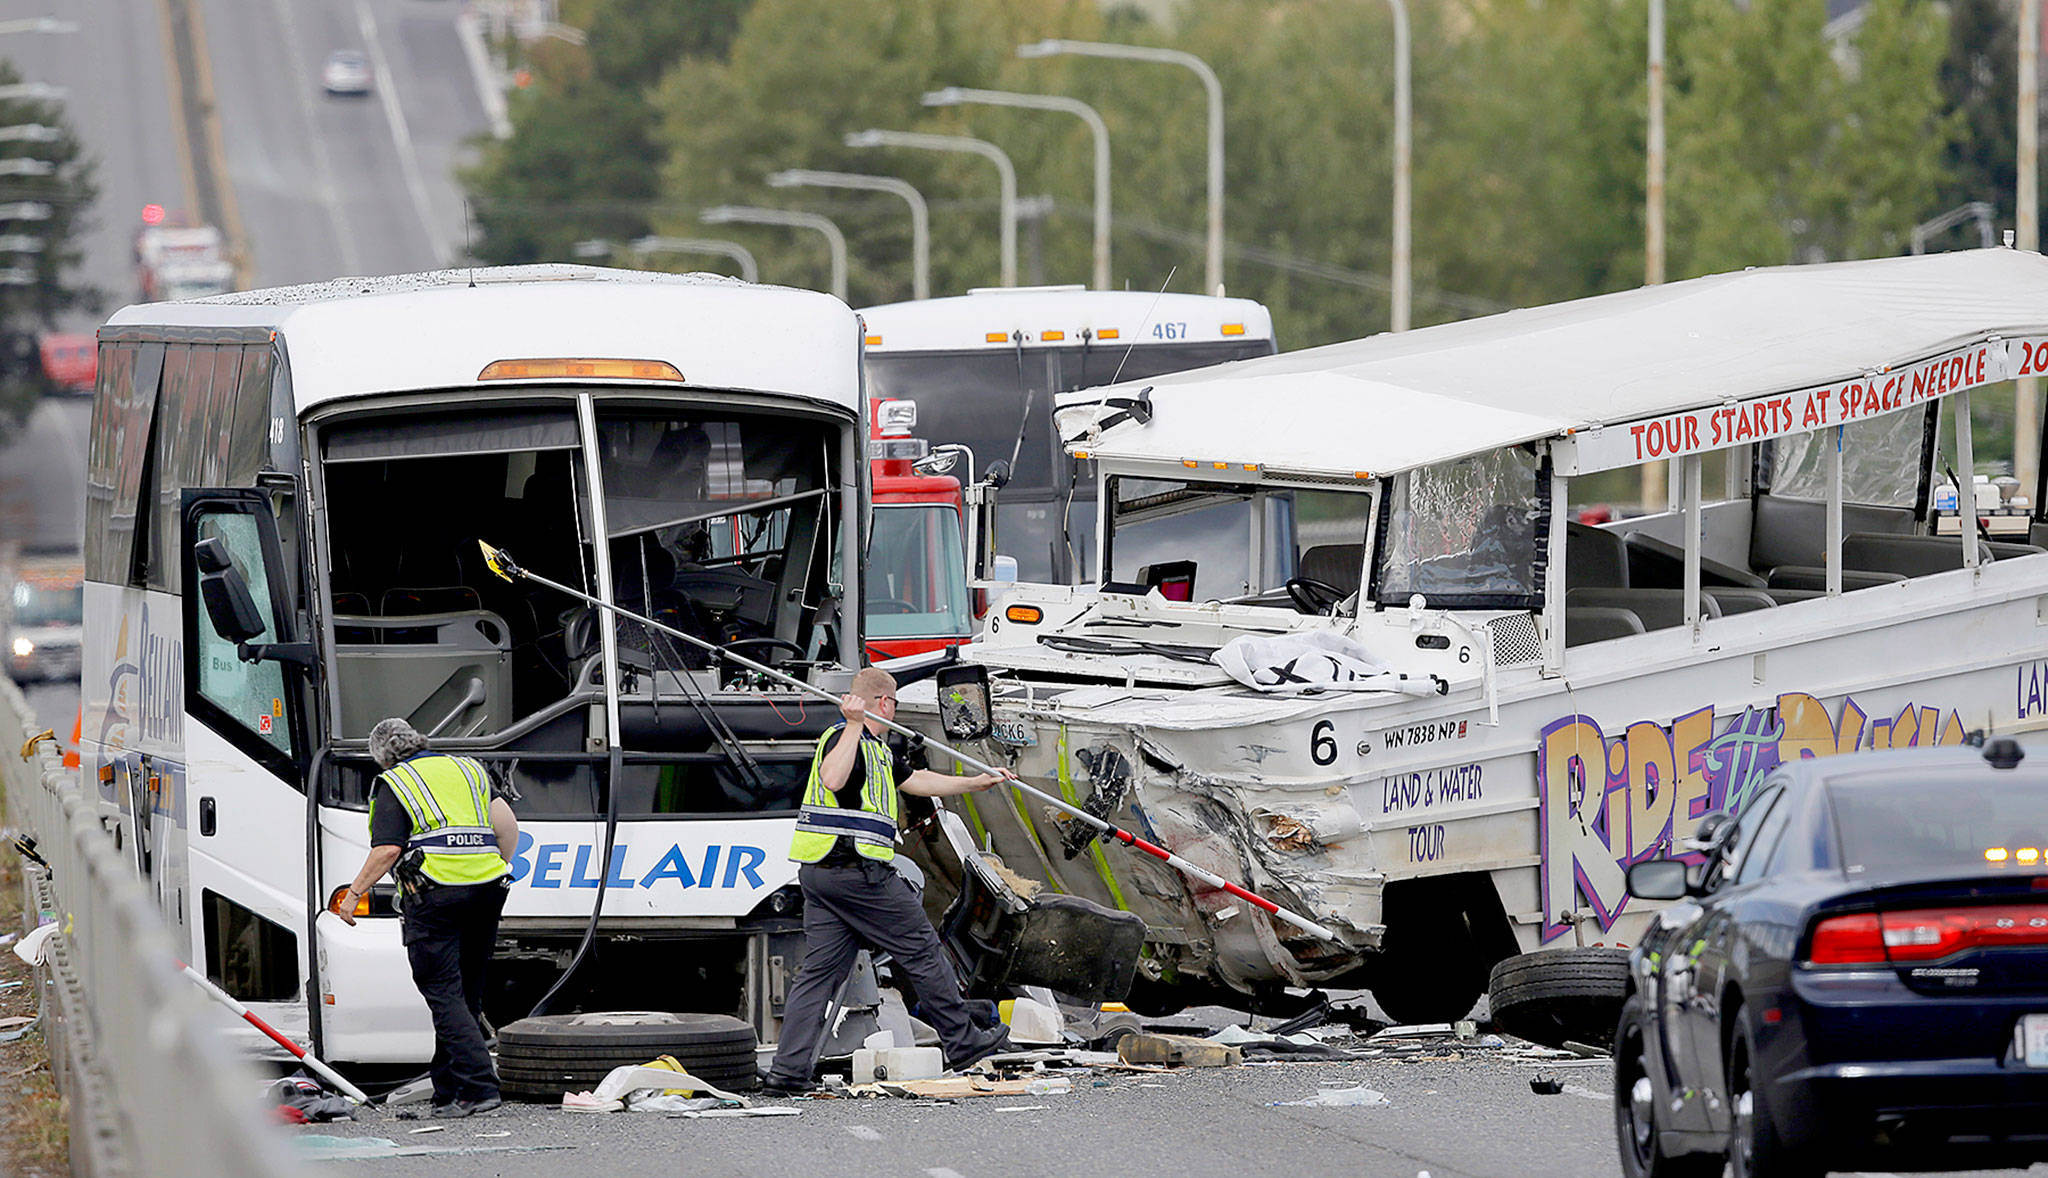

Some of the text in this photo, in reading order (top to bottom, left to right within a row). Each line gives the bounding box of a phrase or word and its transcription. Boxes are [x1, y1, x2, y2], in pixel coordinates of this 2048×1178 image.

[1152, 322, 1187, 340] 467
[1630, 416, 1701, 460] TOUR
[1710, 397, 1793, 446] STARTS
[1802, 391, 1831, 428] AT
[1838, 375, 1906, 421] SPACE
[1910, 348, 1988, 402] NEEDLE
[269, 417, 285, 444] 418
[991, 615, 1000, 634] 6
[212, 657, 233, 673] Bus
[1458, 645, 1471, 664] 6
[1310, 720, 1338, 766] 6
[1384, 728, 1404, 750] WN
[1407, 724, 1436, 746] 7838
[1438, 721, 1457, 741] NP
[1383, 764, 1483, 813] LAND & WATER
[446, 833, 486, 846] POLICE
[1408, 824, 1445, 863] TOUR
[505, 830, 767, 890] BELLAIR
